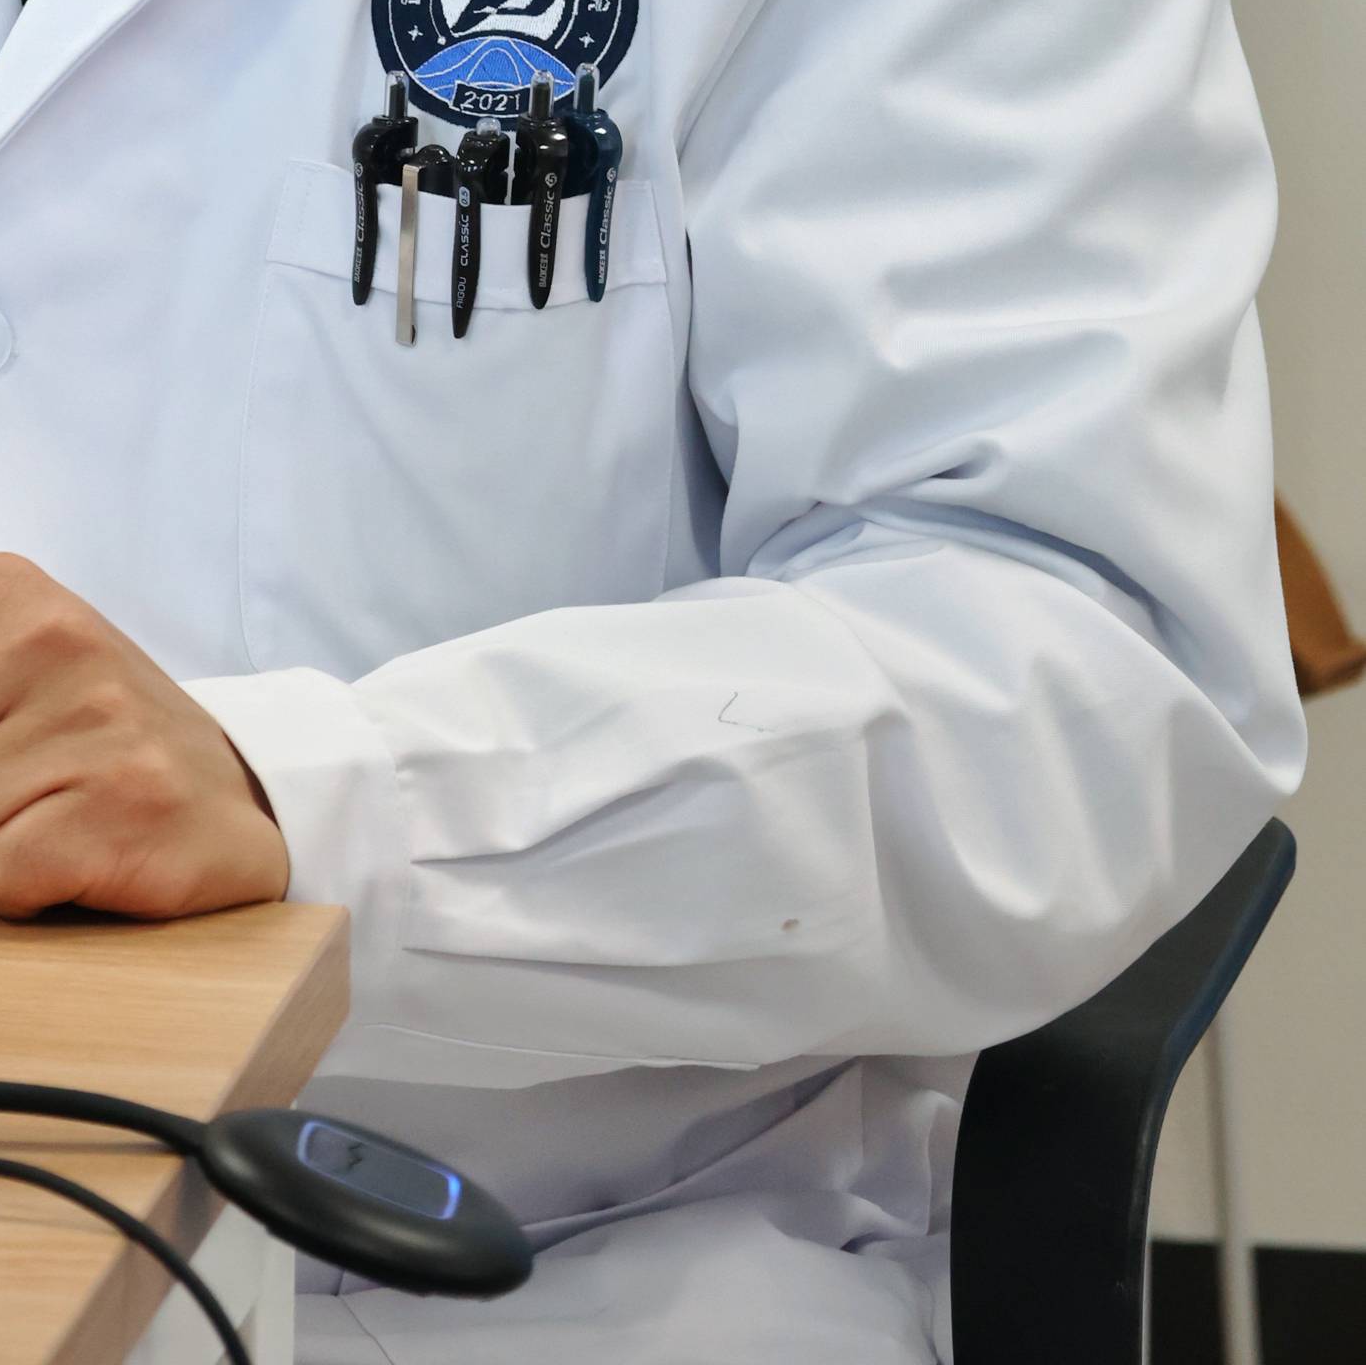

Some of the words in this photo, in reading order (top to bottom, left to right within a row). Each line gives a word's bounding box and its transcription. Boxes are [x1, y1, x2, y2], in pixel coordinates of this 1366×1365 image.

[460, 90, 521, 113] 2021
[354, 182, 366, 243] Classic
[539, 190, 555, 249] Classic
[599, 185, 615, 245] Classic
